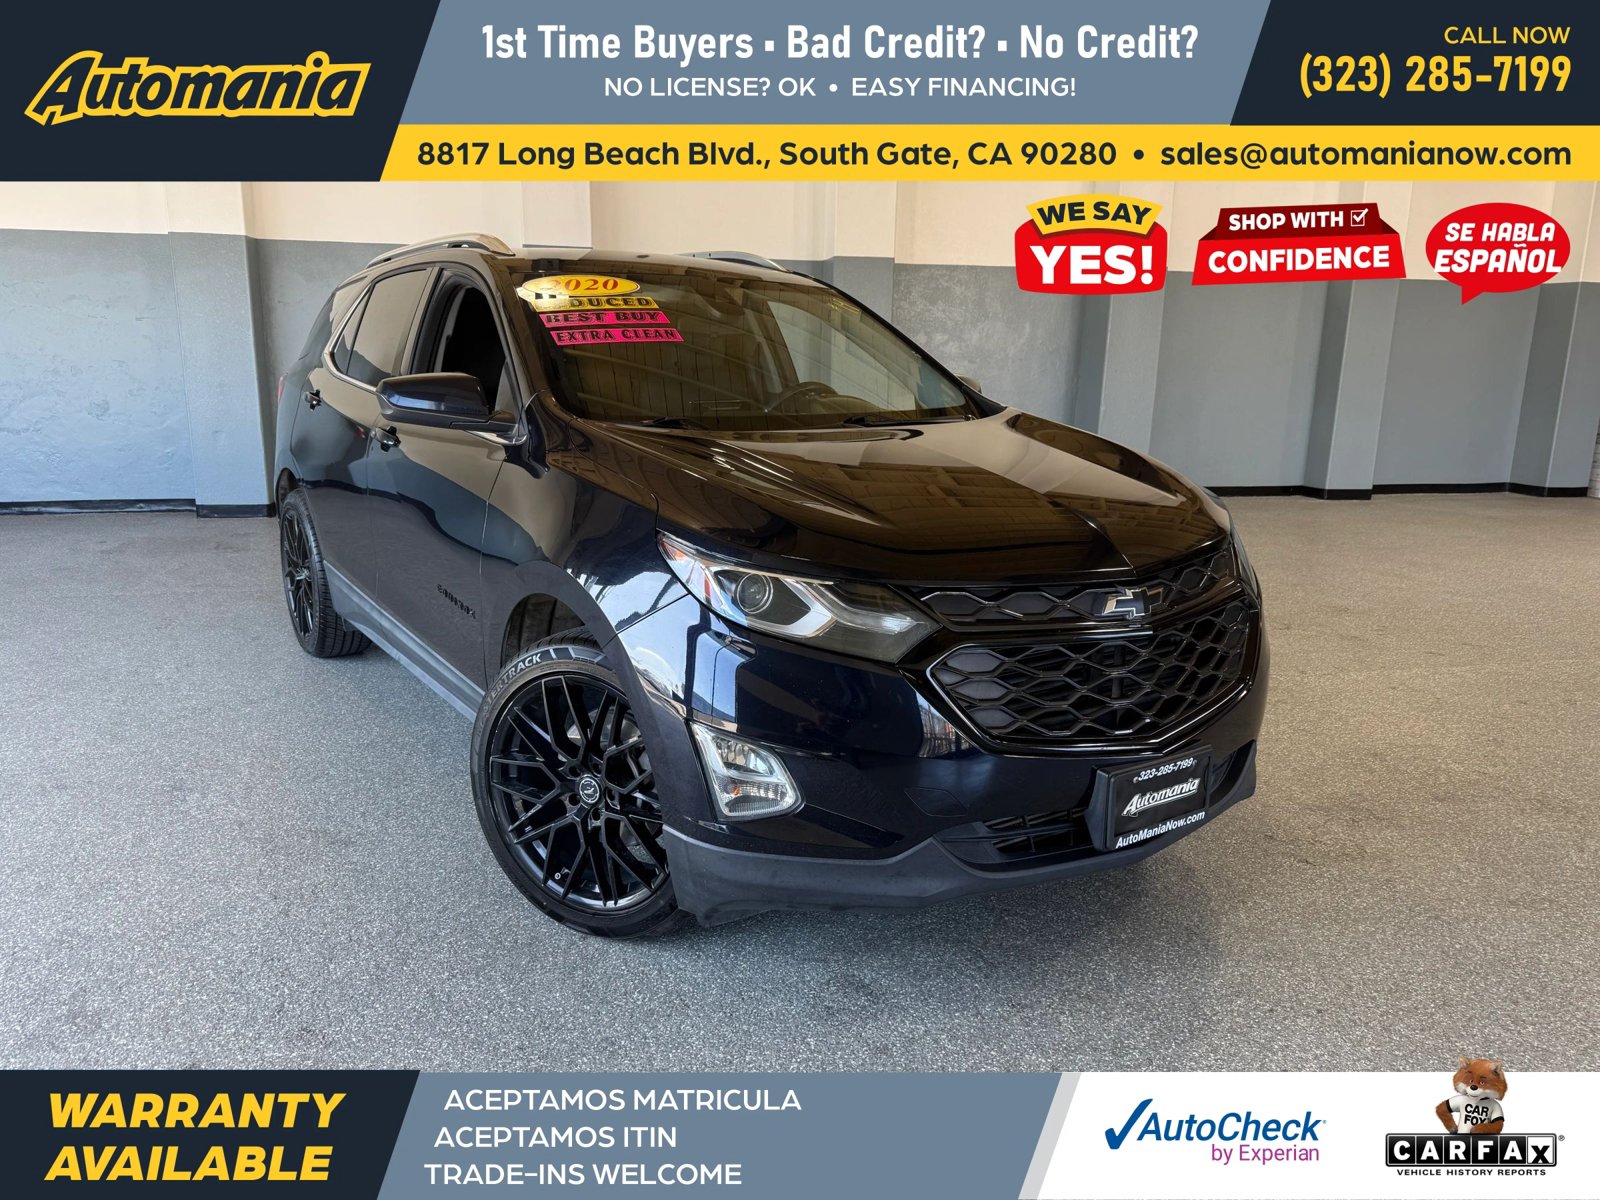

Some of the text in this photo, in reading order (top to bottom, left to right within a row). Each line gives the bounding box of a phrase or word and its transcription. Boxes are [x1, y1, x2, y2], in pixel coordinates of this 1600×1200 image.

[546, 311, 660, 324] BEST BUY
[557, 328, 676, 343] EXTRA CLEAN
[1138, 757, 1194, 781] 323-285-7199
[1121, 777, 1201, 817] Automania
[1115, 811, 1205, 849] AutoManiaNow.com
